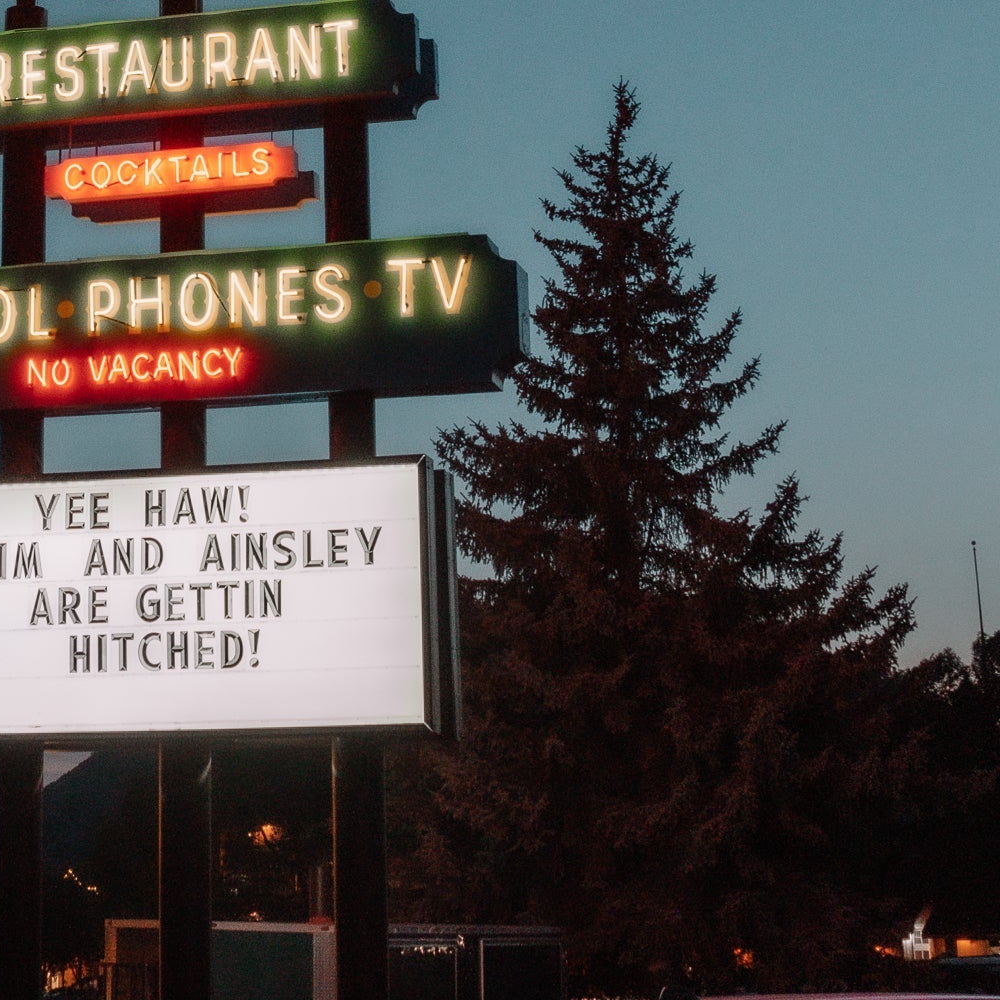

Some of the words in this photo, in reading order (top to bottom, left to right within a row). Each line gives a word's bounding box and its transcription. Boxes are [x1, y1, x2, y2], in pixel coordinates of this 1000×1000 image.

[64, 148, 270, 191] COCKTAILS
[87, 263, 351, 336] PHONES
[385, 254, 473, 318] TV
[27, 358, 71, 387] NO
[88, 347, 244, 382] VACANCY
[35, 491, 110, 531] YEE
[144, 485, 251, 527] HAW!
[84, 536, 164, 576] AND
[200, 526, 382, 572] AINSLEY
[30, 585, 109, 626] ARE
[136, 579, 283, 622] GETTIN
[68, 628, 261, 674] HITCHED!
